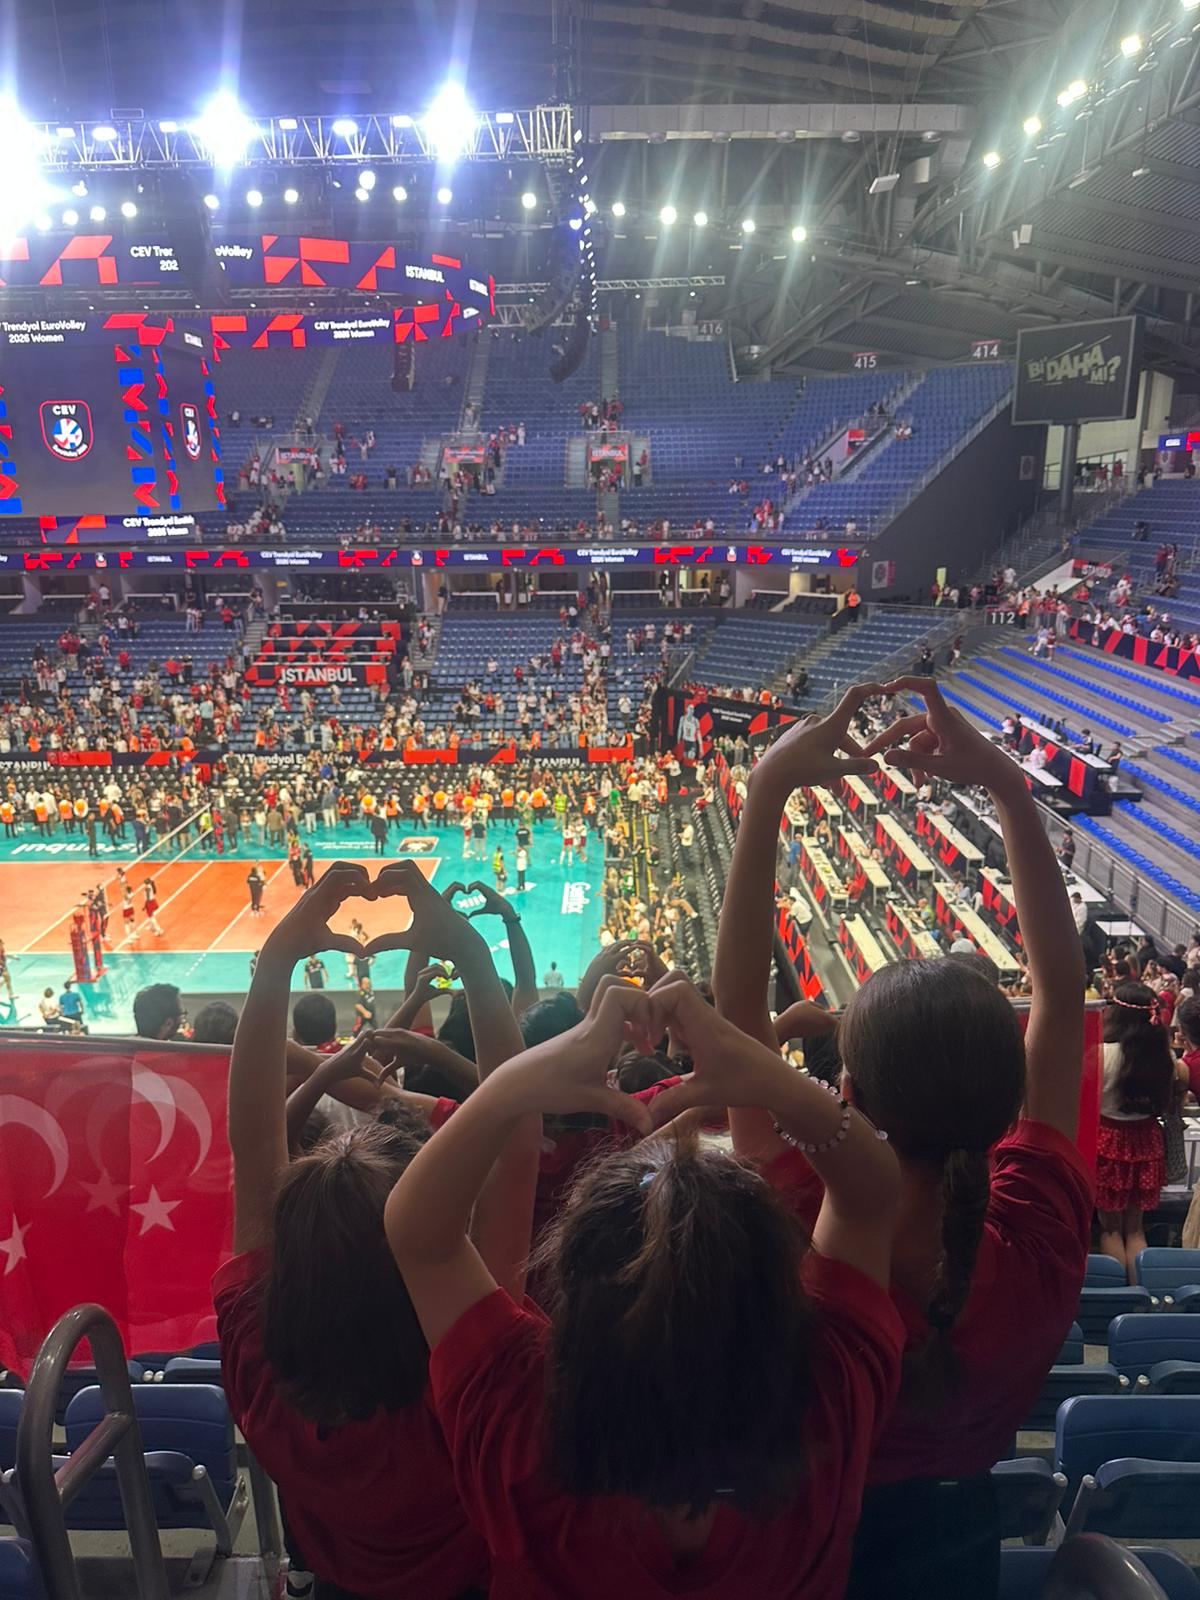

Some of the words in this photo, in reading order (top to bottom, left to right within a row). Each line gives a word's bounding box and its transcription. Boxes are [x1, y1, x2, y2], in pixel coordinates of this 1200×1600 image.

[130, 246, 152, 258] CEV
[405, 265, 445, 283] ISTANBUL
[2, 321, 40, 333] Trendyol
[41, 320, 86, 331] EuroVolley
[700, 323, 723, 334] 416
[8, 333, 30, 343] 2026
[31, 333, 64, 343] Women
[972, 344, 999, 359] 414
[854, 355, 877, 368] 415
[1046, 345, 1105, 381] DAHA
[52, 404, 76, 415] CEV
[992, 611, 1015, 624] 112
[279, 668, 357, 684] ISTANBUL
